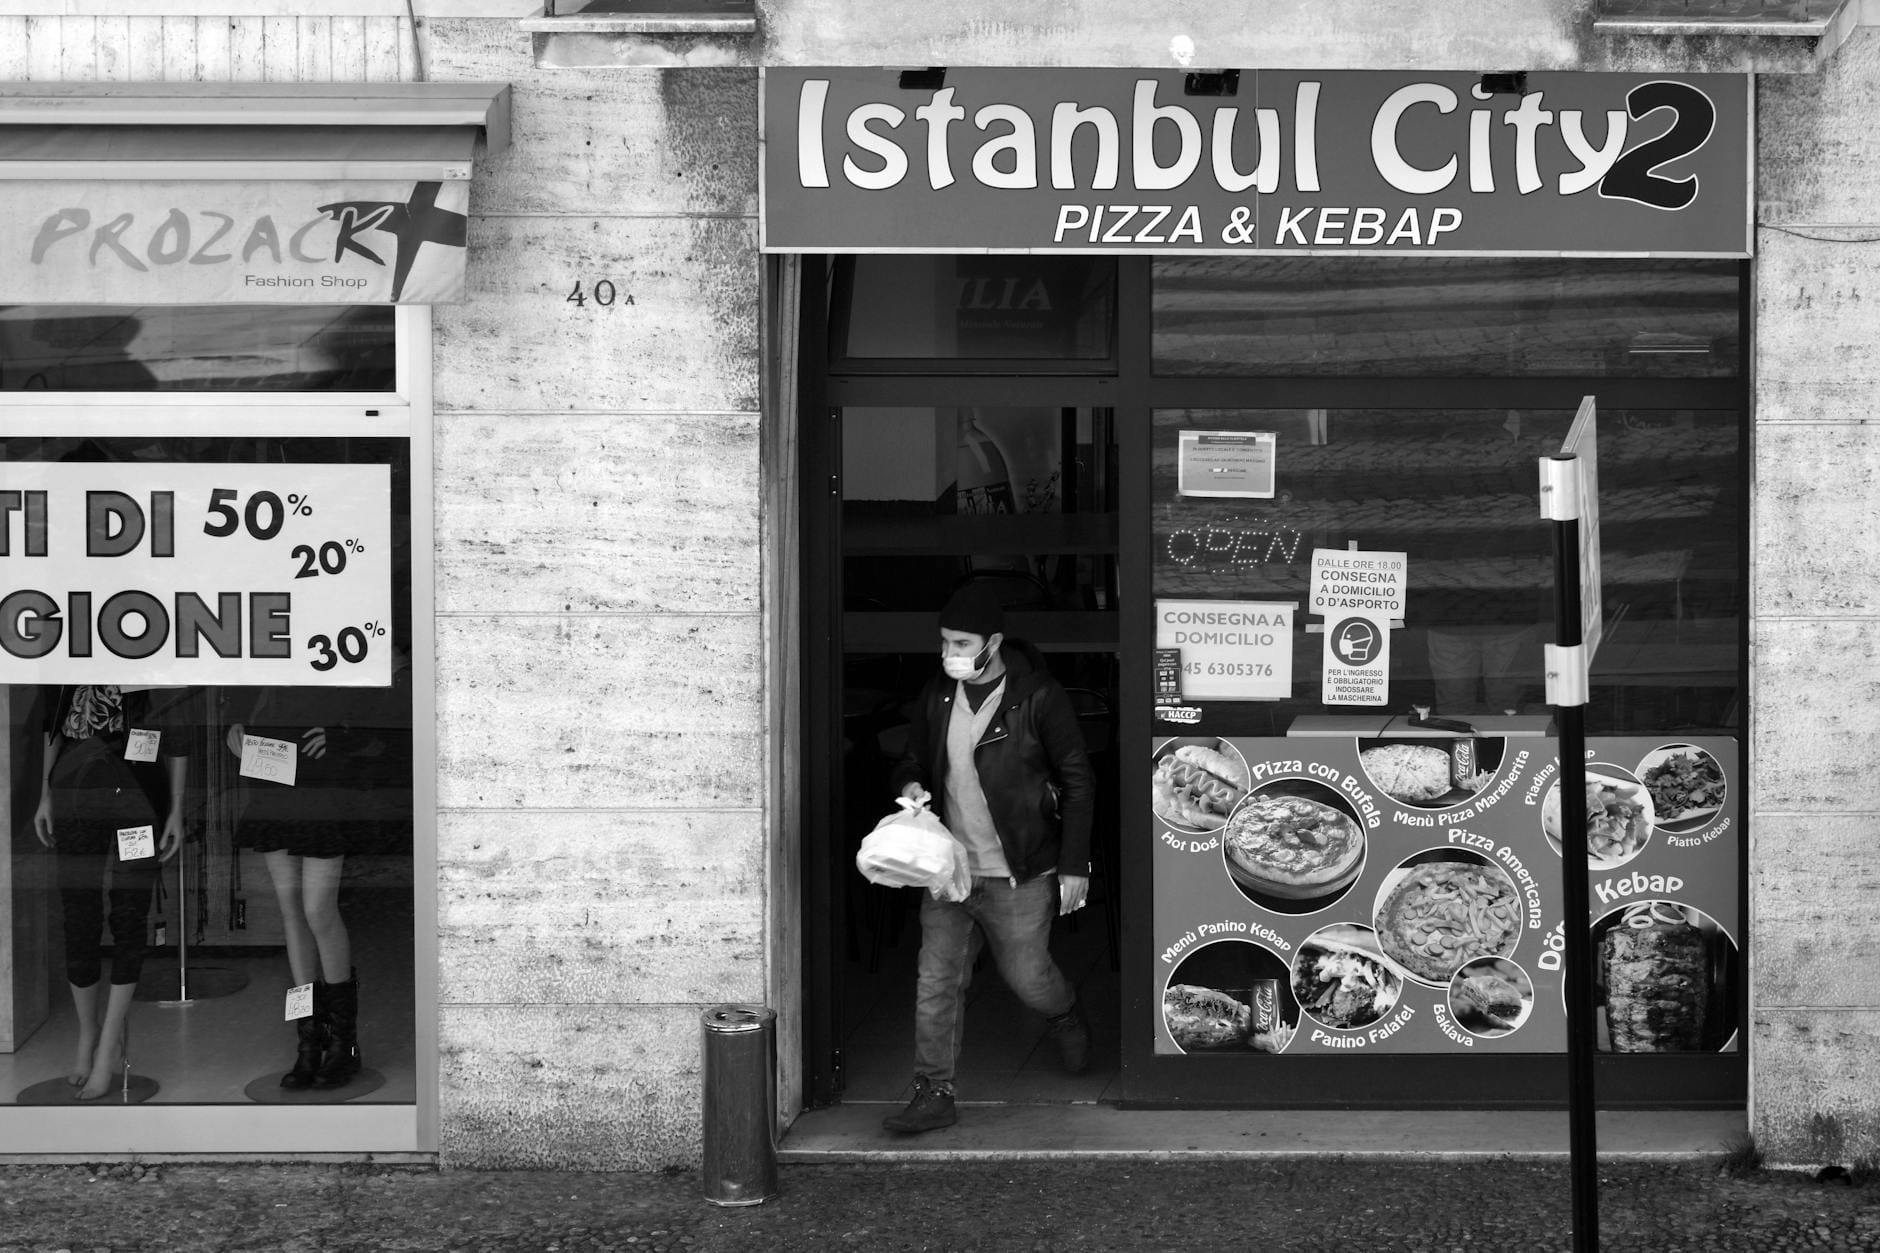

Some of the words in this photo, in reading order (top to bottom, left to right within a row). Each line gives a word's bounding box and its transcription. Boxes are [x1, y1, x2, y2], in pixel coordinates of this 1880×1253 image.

[797, 79, 1322, 194] Istanbul
[1053, 204, 1203, 243] PIZZA
[1221, 205, 1255, 244] &
[1275, 206, 1463, 246] KEBAP
[245, 274, 314, 288] Fashion
[320, 275, 368, 289] Shop
[86, 490, 175, 557] DI
[203, 487, 313, 541] 50%
[291, 537, 365, 579] 20%
[1168, 529, 1300, 564] OPEN
[1317, 558, 1350, 568] DALLE
[1352, 560, 1374, 569] ORE
[1320, 584, 1329, 594] A
[1332, 585, 1396, 597] DOMICILIO
[1321, 570, 1397, 583] CONSEGNA
[1163, 611, 1269, 626] CONSEGNA
[1273, 614, 1286, 627] A
[1315, 596, 1325, 606] O
[1328, 597, 1399, 610] D'ASPORTO
[0, 589, 292, 659] GIONE
[1175, 631, 1274, 646] DOMICILIO
[307, 620, 386, 672] 30%
[1181, 662, 1202, 675] 45
[1207, 662, 1273, 677] 6305376
[1343, 669, 1383, 677] L'INGRESSO
[1168, 711, 1197, 719] HACCP
[1252, 760, 1302, 780] Pizza
[1308, 761, 1340, 782] con
[1341, 774, 1381, 829] Bufala
[1393, 810, 1434, 827] Menù
[1438, 808, 1475, 826] Pizza
[1474, 749, 1530, 813] Margherita
[1525, 763, 1556, 805] Piadina
[1161, 831, 1187, 851] Hot
[1190, 836, 1220, 853] Dog
[1667, 835, 1701, 847] Piatto
[1702, 817, 1731, 843] Kebap
[1448, 828, 1494, 852] Pizza
[1496, 846, 1542, 929] Americana
[1595, 871, 1684, 905] Kebap
[1161, 930, 1198, 963] Menù
[1198, 920, 1247, 937] Panino
[1250, 922, 1291, 953] Kebap
[1310, 1029, 1366, 1048] Panino
[1369, 1004, 1415, 1043] Falafel
[1433, 1003, 1473, 1047] Baklava
